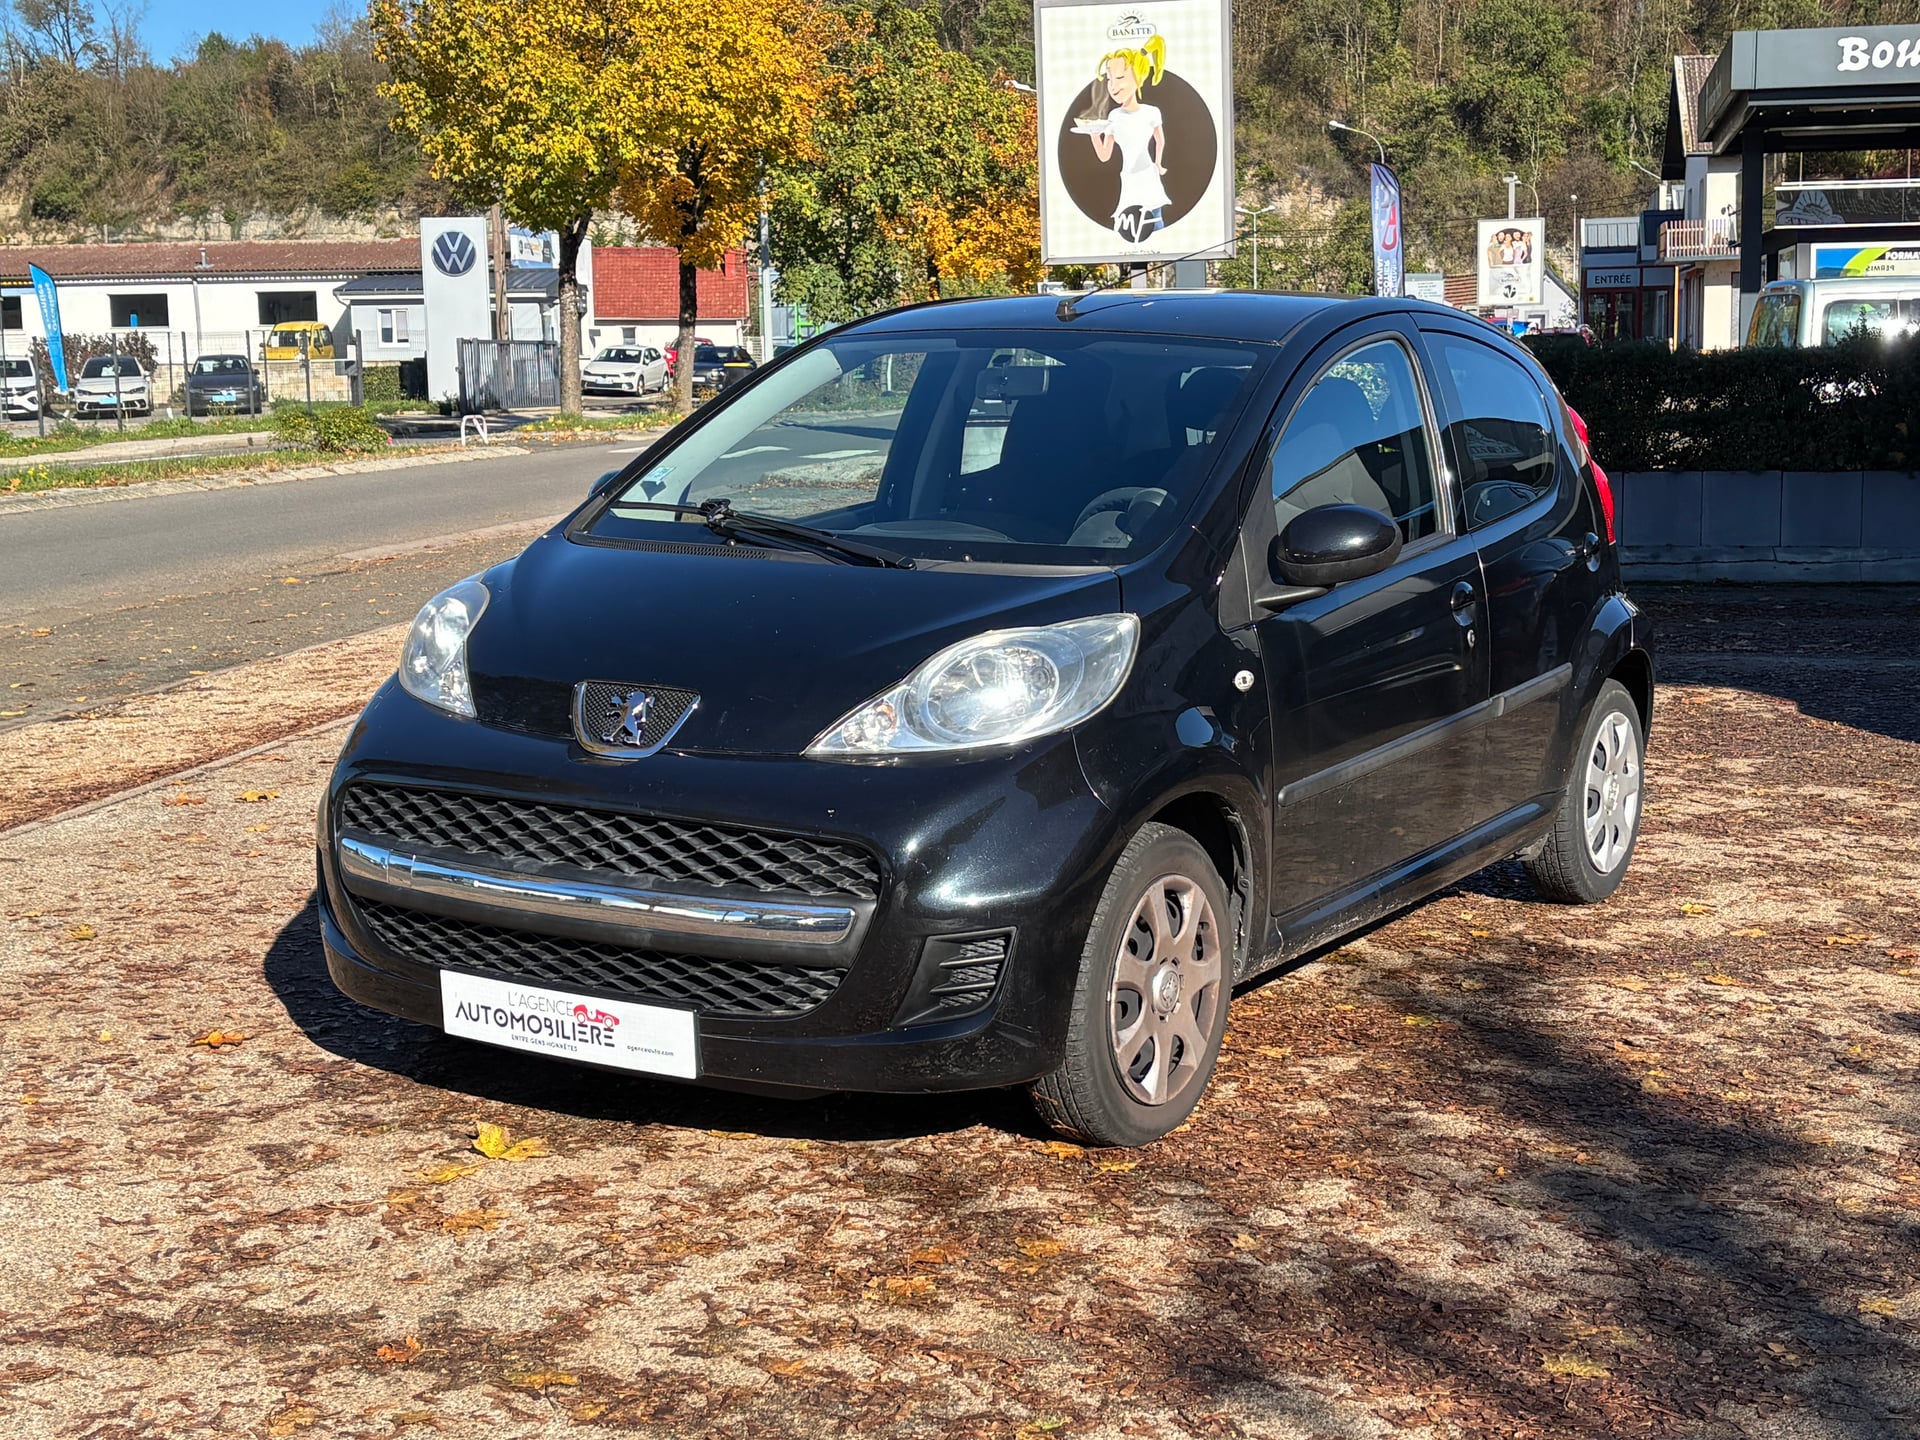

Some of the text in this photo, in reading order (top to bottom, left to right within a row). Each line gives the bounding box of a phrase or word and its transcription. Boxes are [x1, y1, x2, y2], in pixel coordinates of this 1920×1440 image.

[1111, 27, 1153, 37] BANETTE
[432, 230, 475, 274] VW
[1885, 251, 1920, 260] FORMA
[1594, 273, 1632, 284] ENTRÉE
[508, 991, 574, 1017] L'AGENCE
